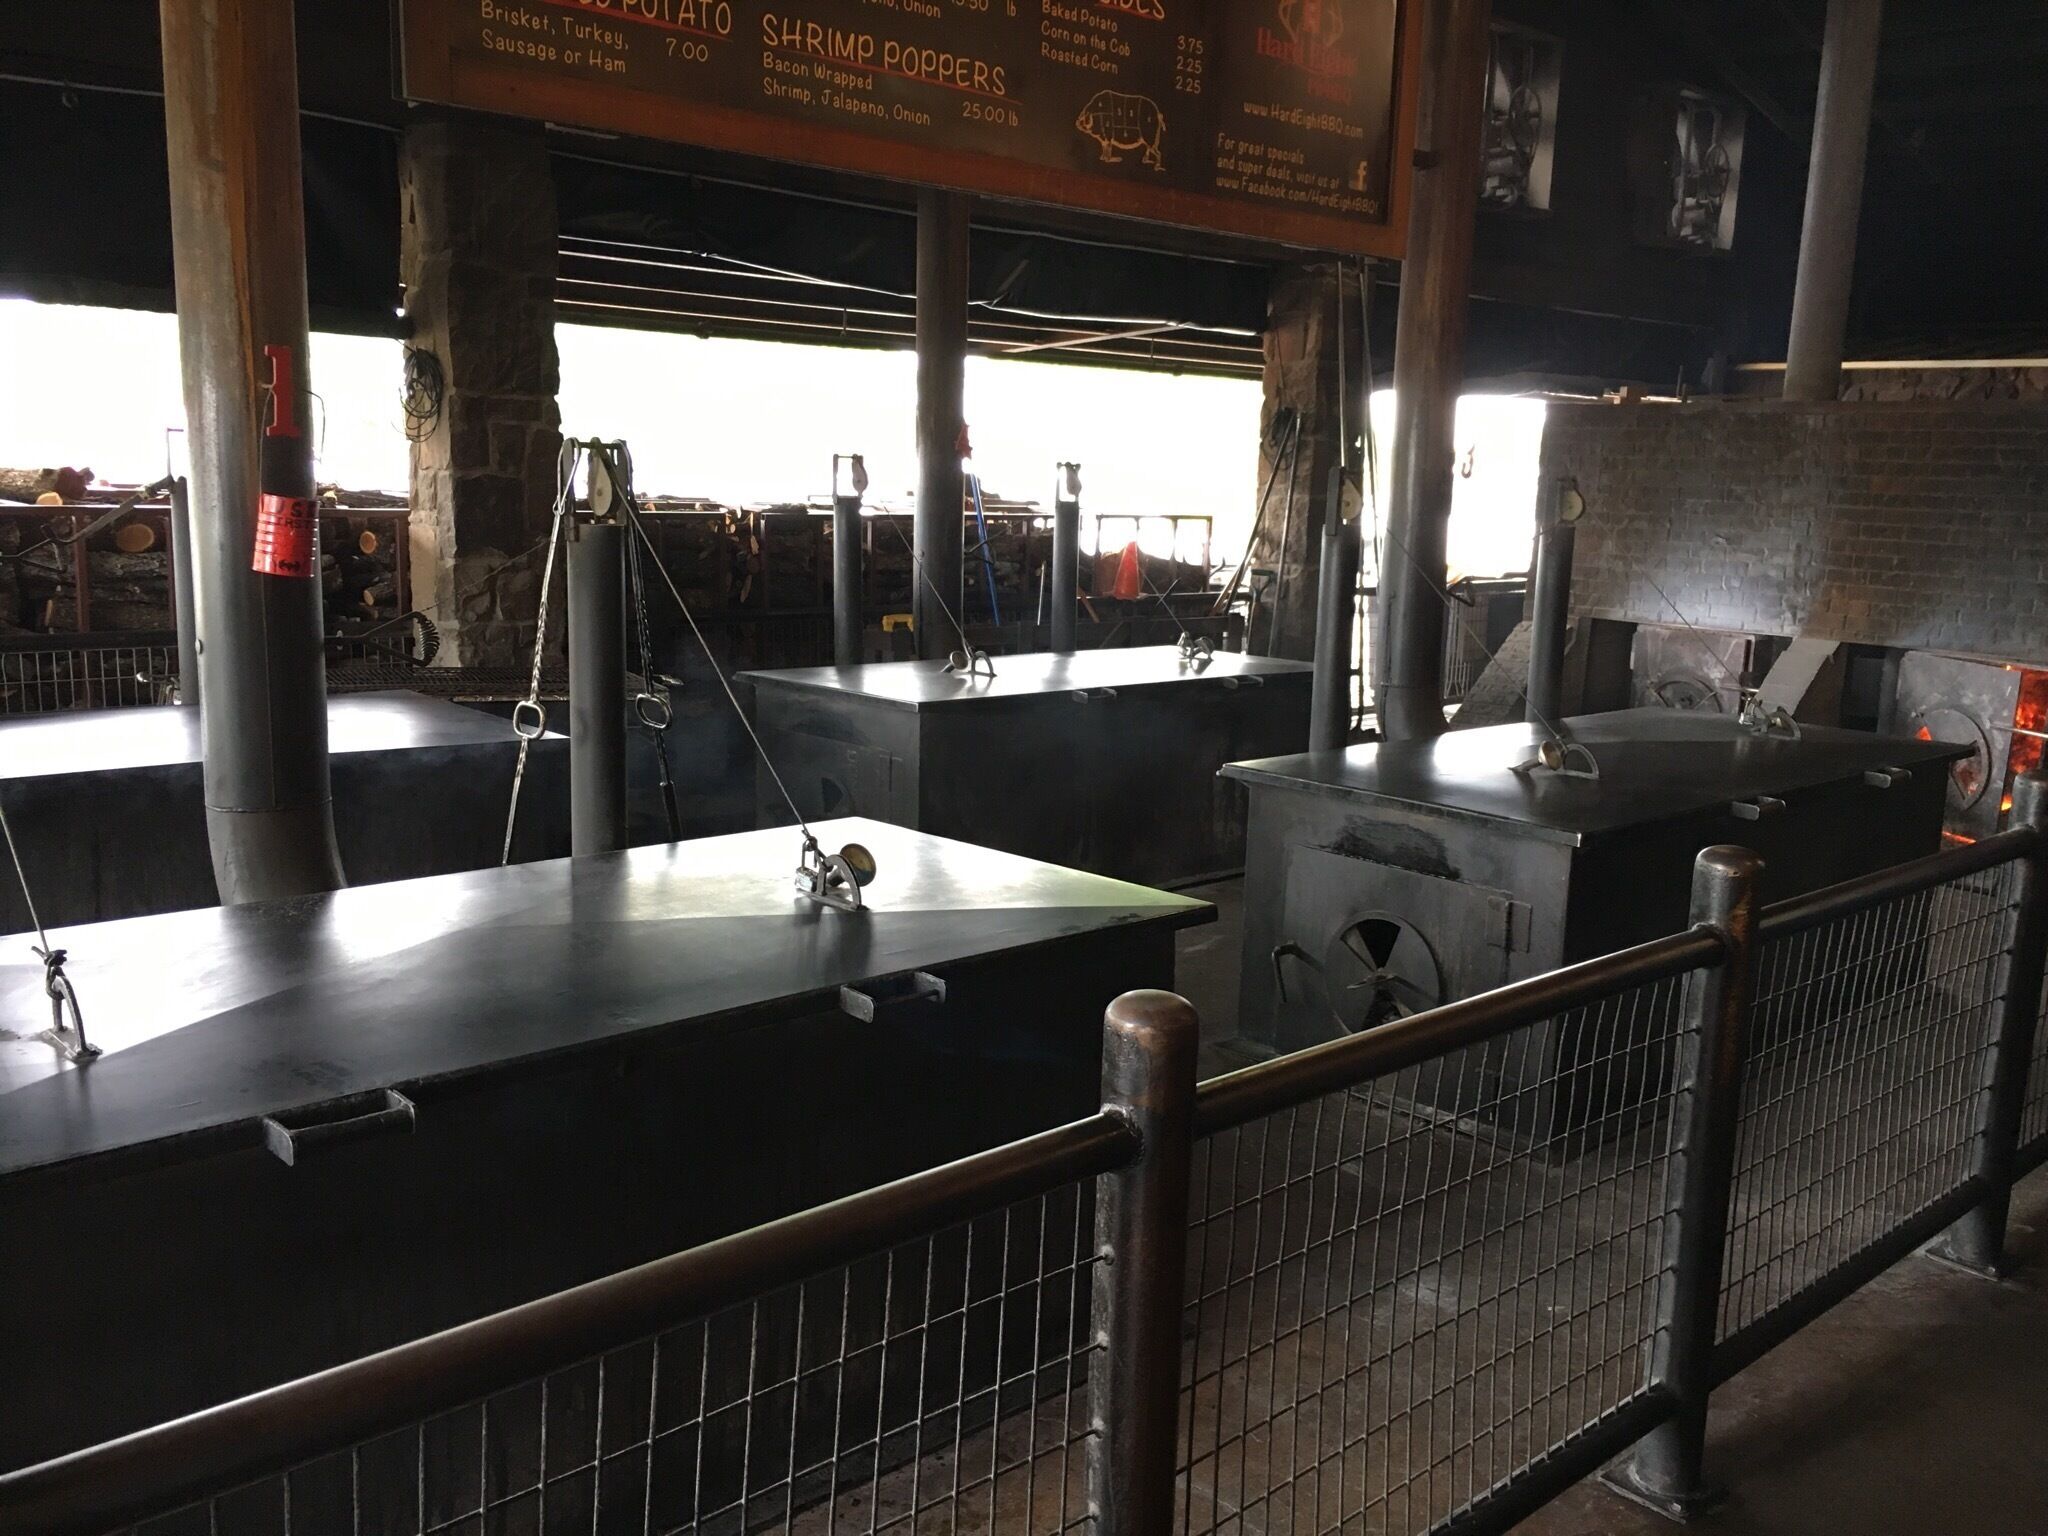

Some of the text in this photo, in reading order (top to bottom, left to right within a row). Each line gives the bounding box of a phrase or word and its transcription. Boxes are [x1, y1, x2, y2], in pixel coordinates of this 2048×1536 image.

[481, 0, 629, 50] Brisket, Turkey,
[1042, 0, 1077, 21] Baked
[1080, 9, 1118, 33] Potato
[481, 28, 626, 73] Sausage or Ham
[665, 38, 710, 62] 7.00
[762, 13, 1006, 97] SHRIMP POPPERS
[1041, 20, 1131, 57] Corn on the Cob
[763, 51, 873, 92] Bacon Wrapped
[1041, 42, 1119, 75] Roasted Corn
[763, 76, 931, 127] Shrimp, Jalapeno, Onion
[1175, 76, 1202, 95] 2.25
[1008, 111, 1019, 127] lb
[1217, 132, 1304, 165] For great specials
[1217, 155, 1236, 170] and
[1237, 160, 1263, 177] super
